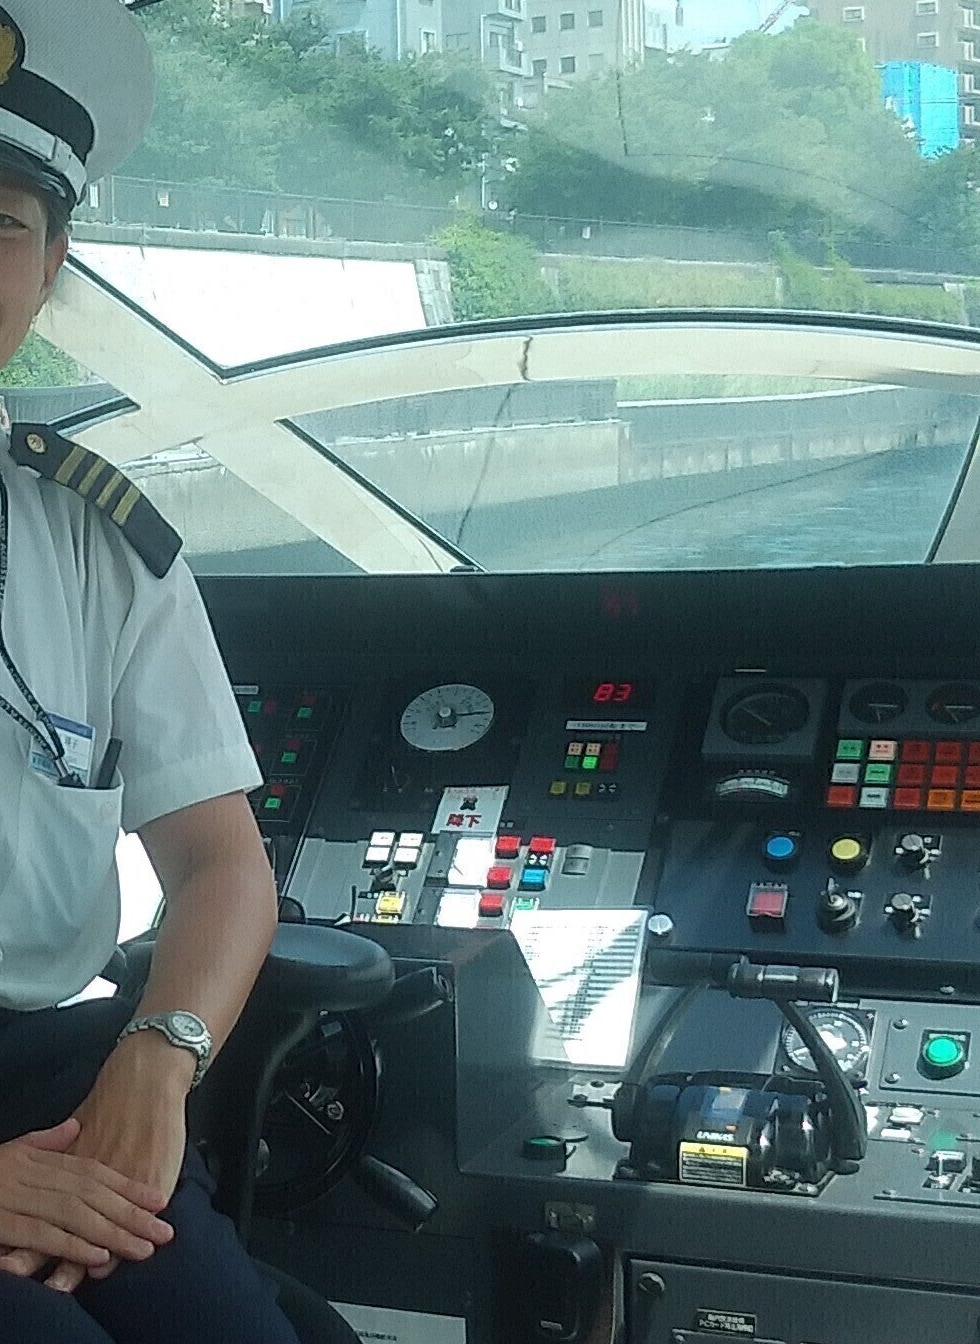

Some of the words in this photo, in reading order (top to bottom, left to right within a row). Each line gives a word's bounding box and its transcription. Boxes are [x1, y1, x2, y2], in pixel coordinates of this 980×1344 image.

[7, 666, 33, 701] ACROSS
[593, 683, 632, 703] 83
[445, 813, 483, 829] 降下
